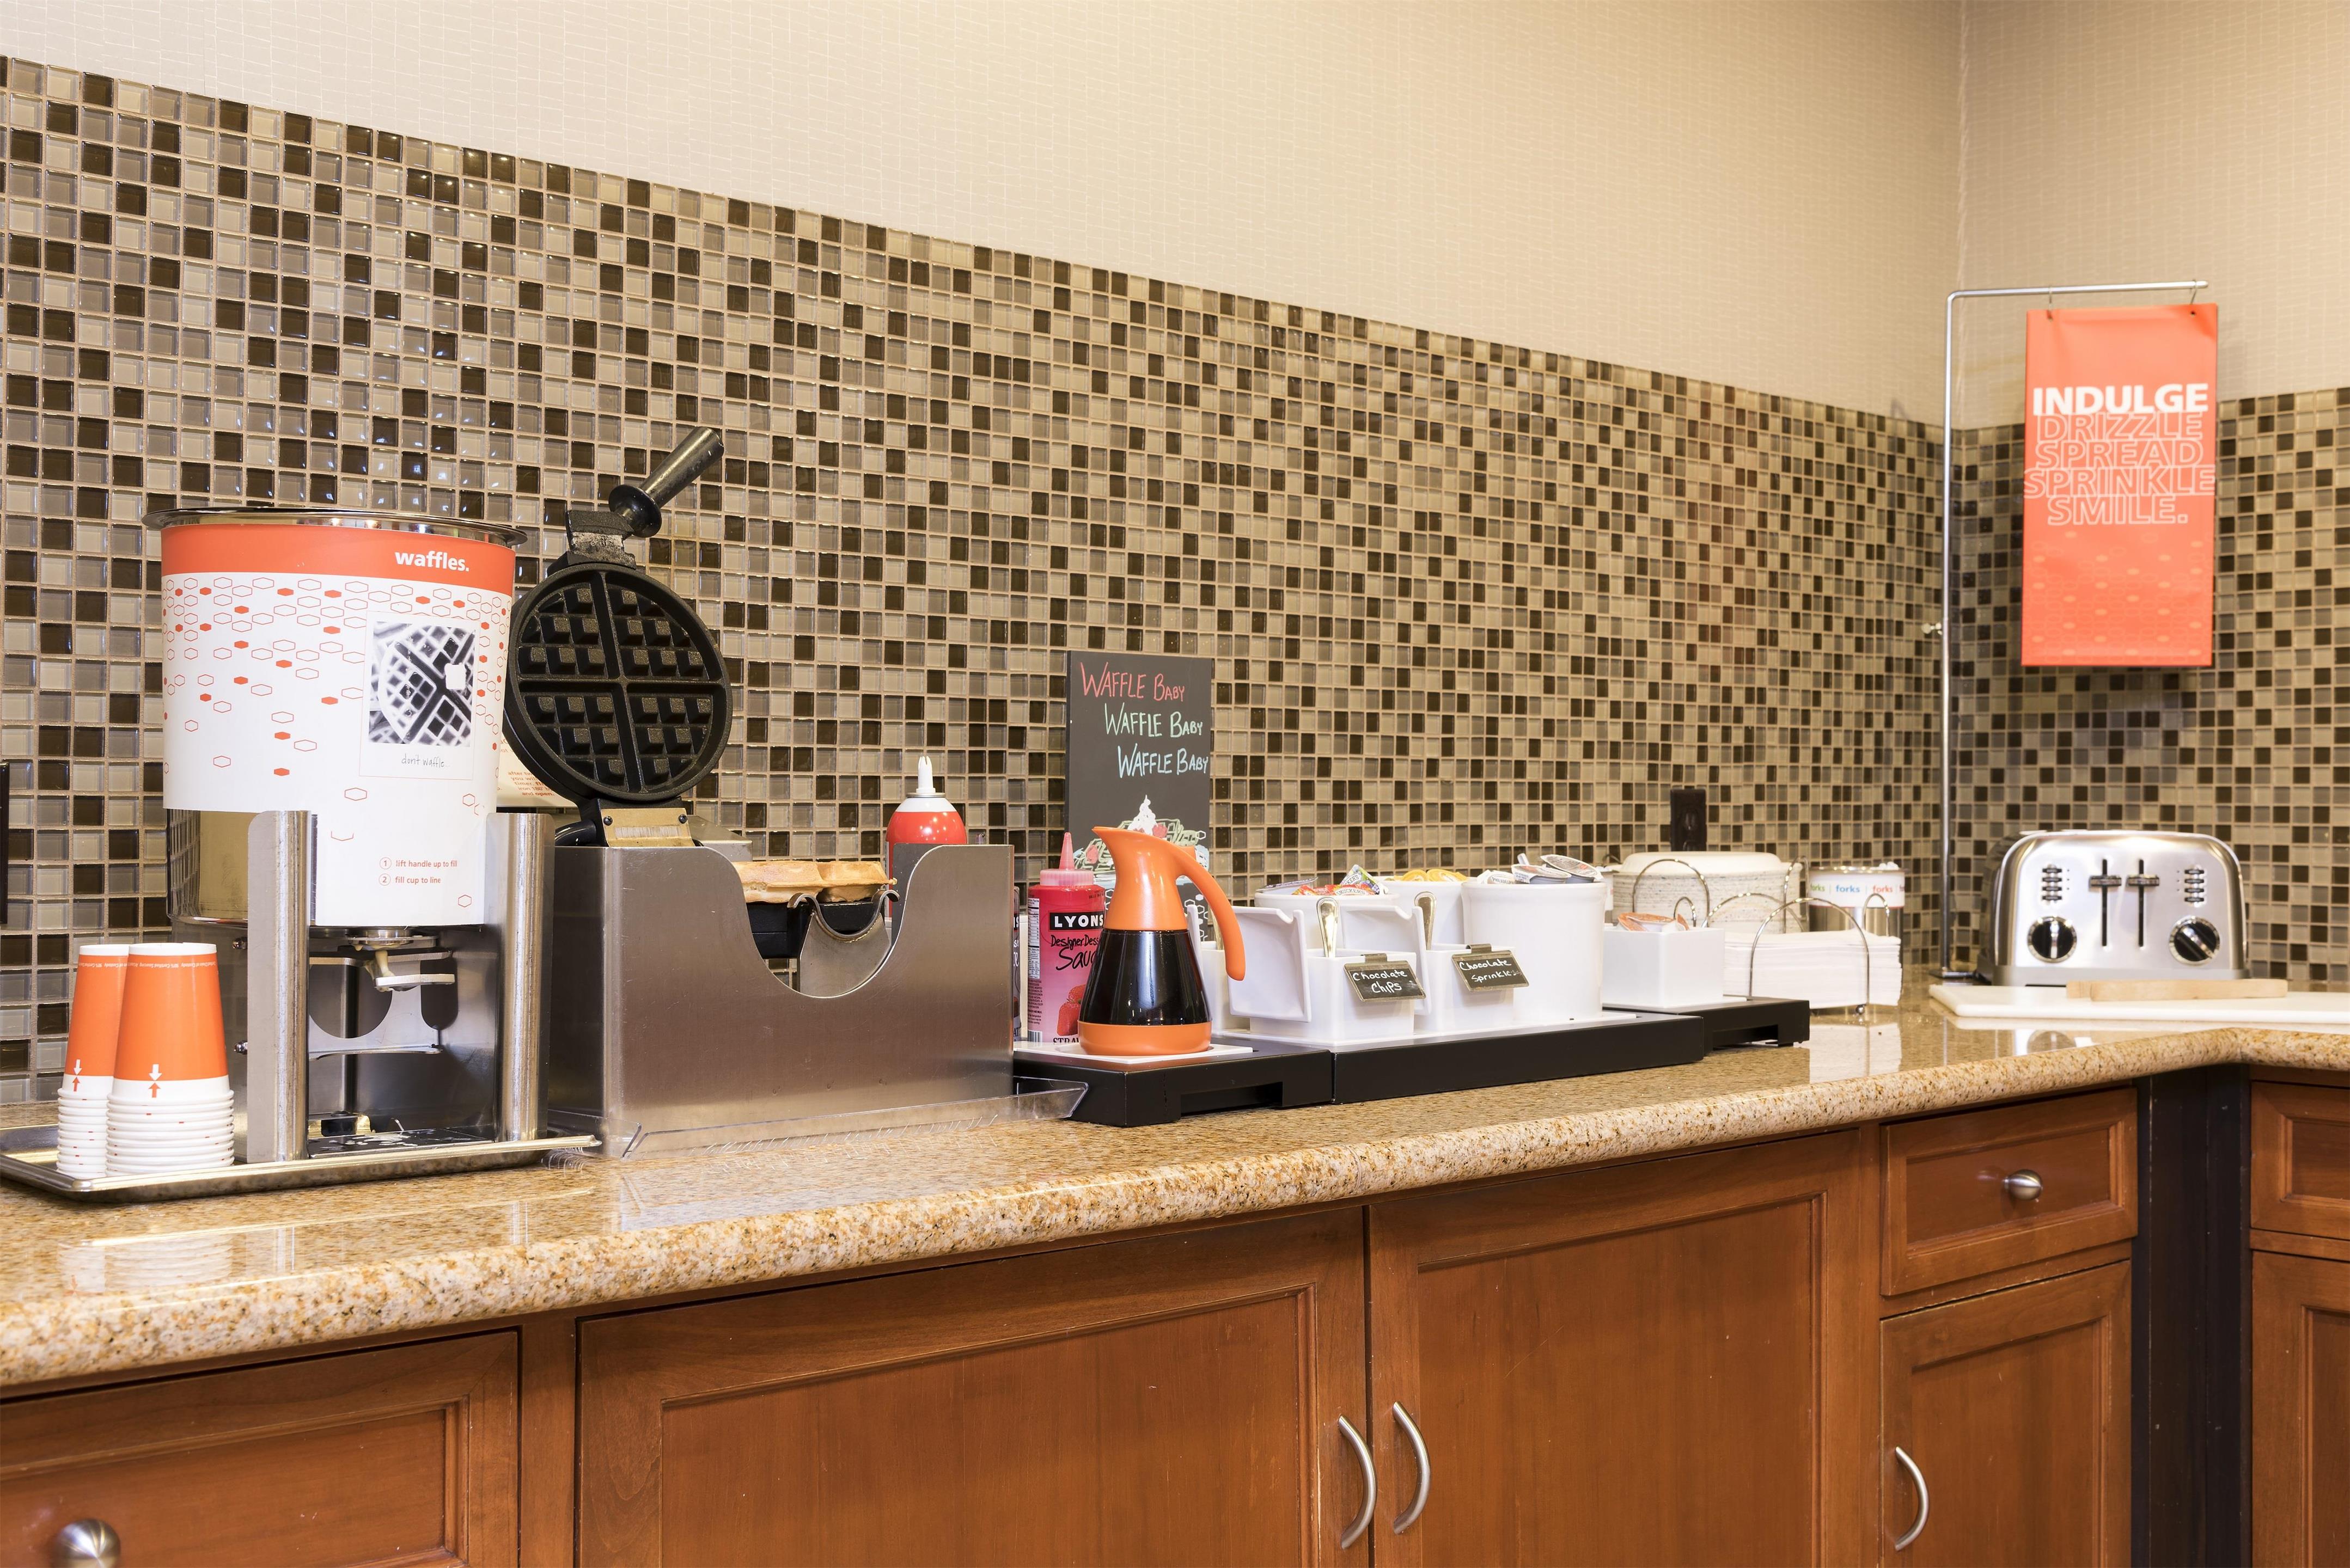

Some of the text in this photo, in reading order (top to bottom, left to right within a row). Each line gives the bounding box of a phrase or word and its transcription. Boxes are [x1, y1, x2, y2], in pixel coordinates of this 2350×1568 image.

[2033, 383, 2209, 416] INDULGE
[2037, 412, 2203, 443] DRIZZLE
[2035, 439, 2204, 470] SPREAD
[2023, 464, 2215, 499] SPRINKLE
[2047, 492, 2188, 526] SMILE.
[394, 550, 469, 572] waffles.
[1081, 661, 1146, 699] WAFFLE
[1104, 702, 1162, 737] WAFFLE
[1118, 743, 1173, 779] WAFFLE
[1835, 884, 1860, 893] forks
[1054, 915, 1103, 927] LYONS
[1051, 934, 1099, 950] Designer Dess
